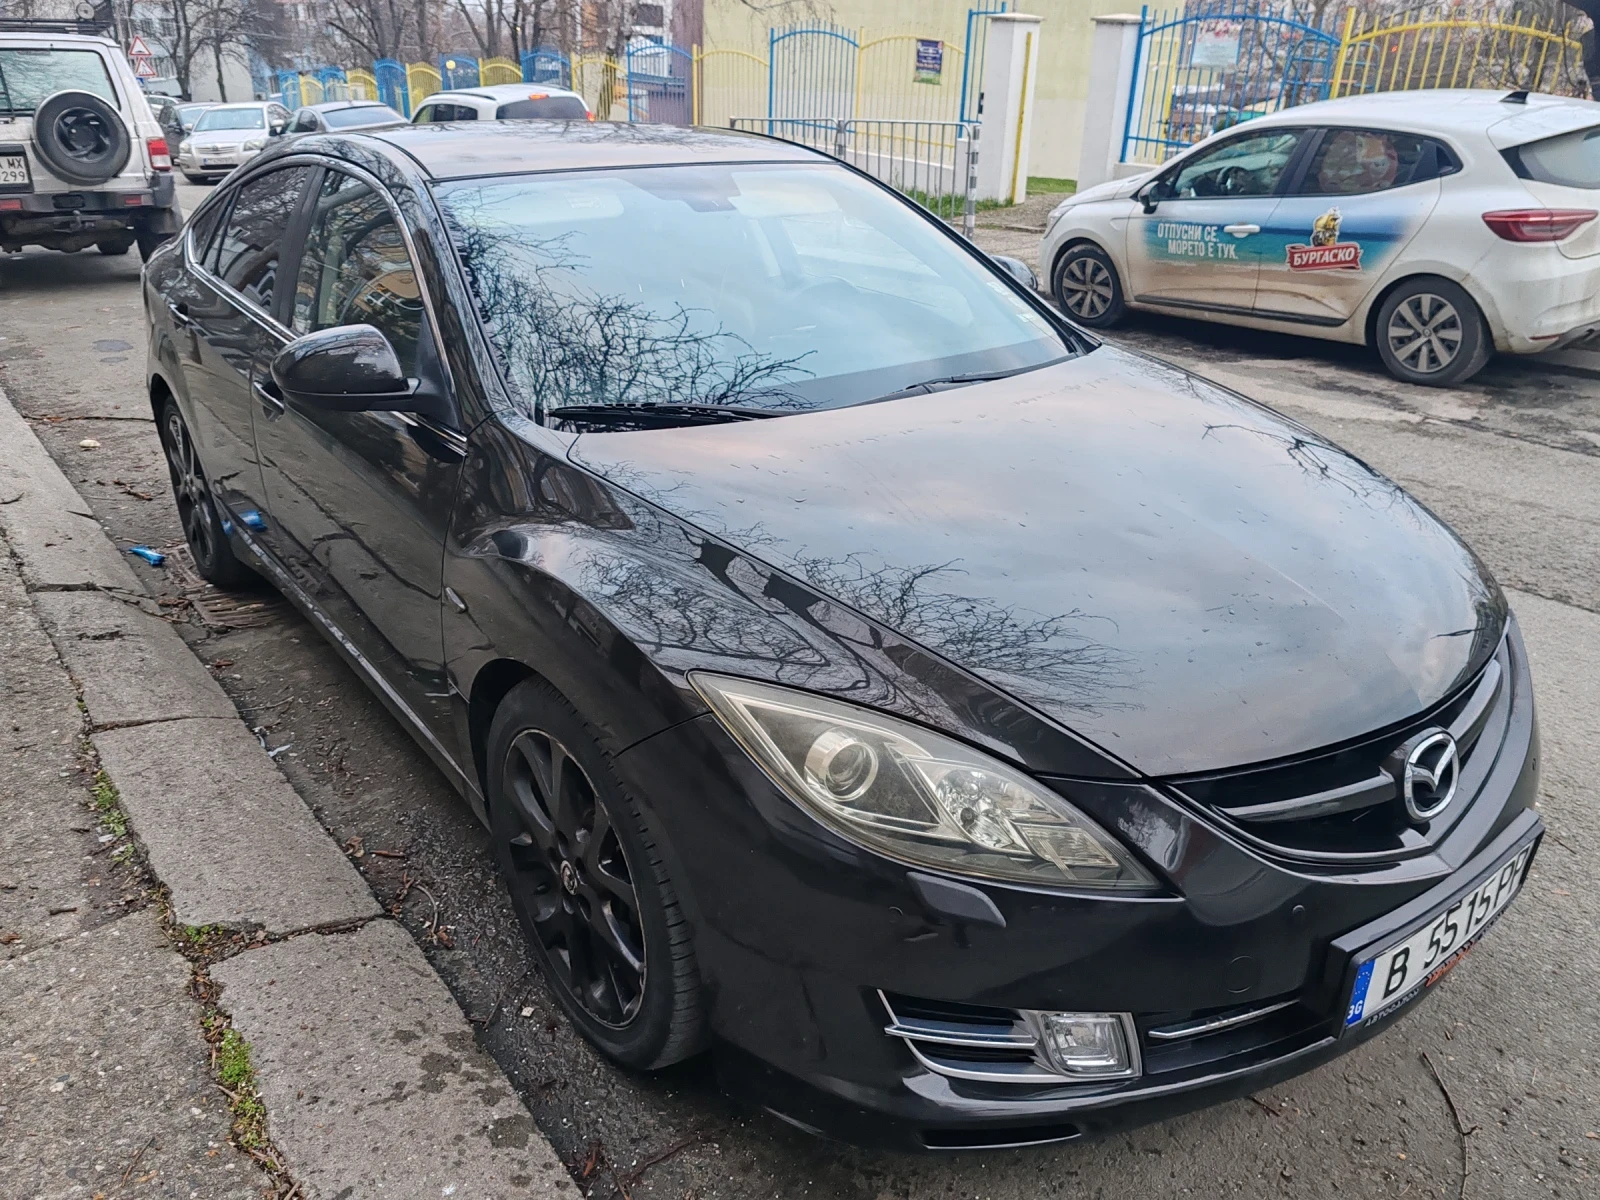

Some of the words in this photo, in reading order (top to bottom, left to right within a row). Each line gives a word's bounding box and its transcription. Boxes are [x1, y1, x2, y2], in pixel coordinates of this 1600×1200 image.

[0, 170, 25, 182] 299
[1157, 223, 1202, 240] ОТПУСНИ
[1168, 241, 1205, 256] МОРЕТО
[1208, 243, 1214, 257] Е
[1293, 248, 1355, 266] БУРГАСКО
[1382, 946, 1411, 1000] B
